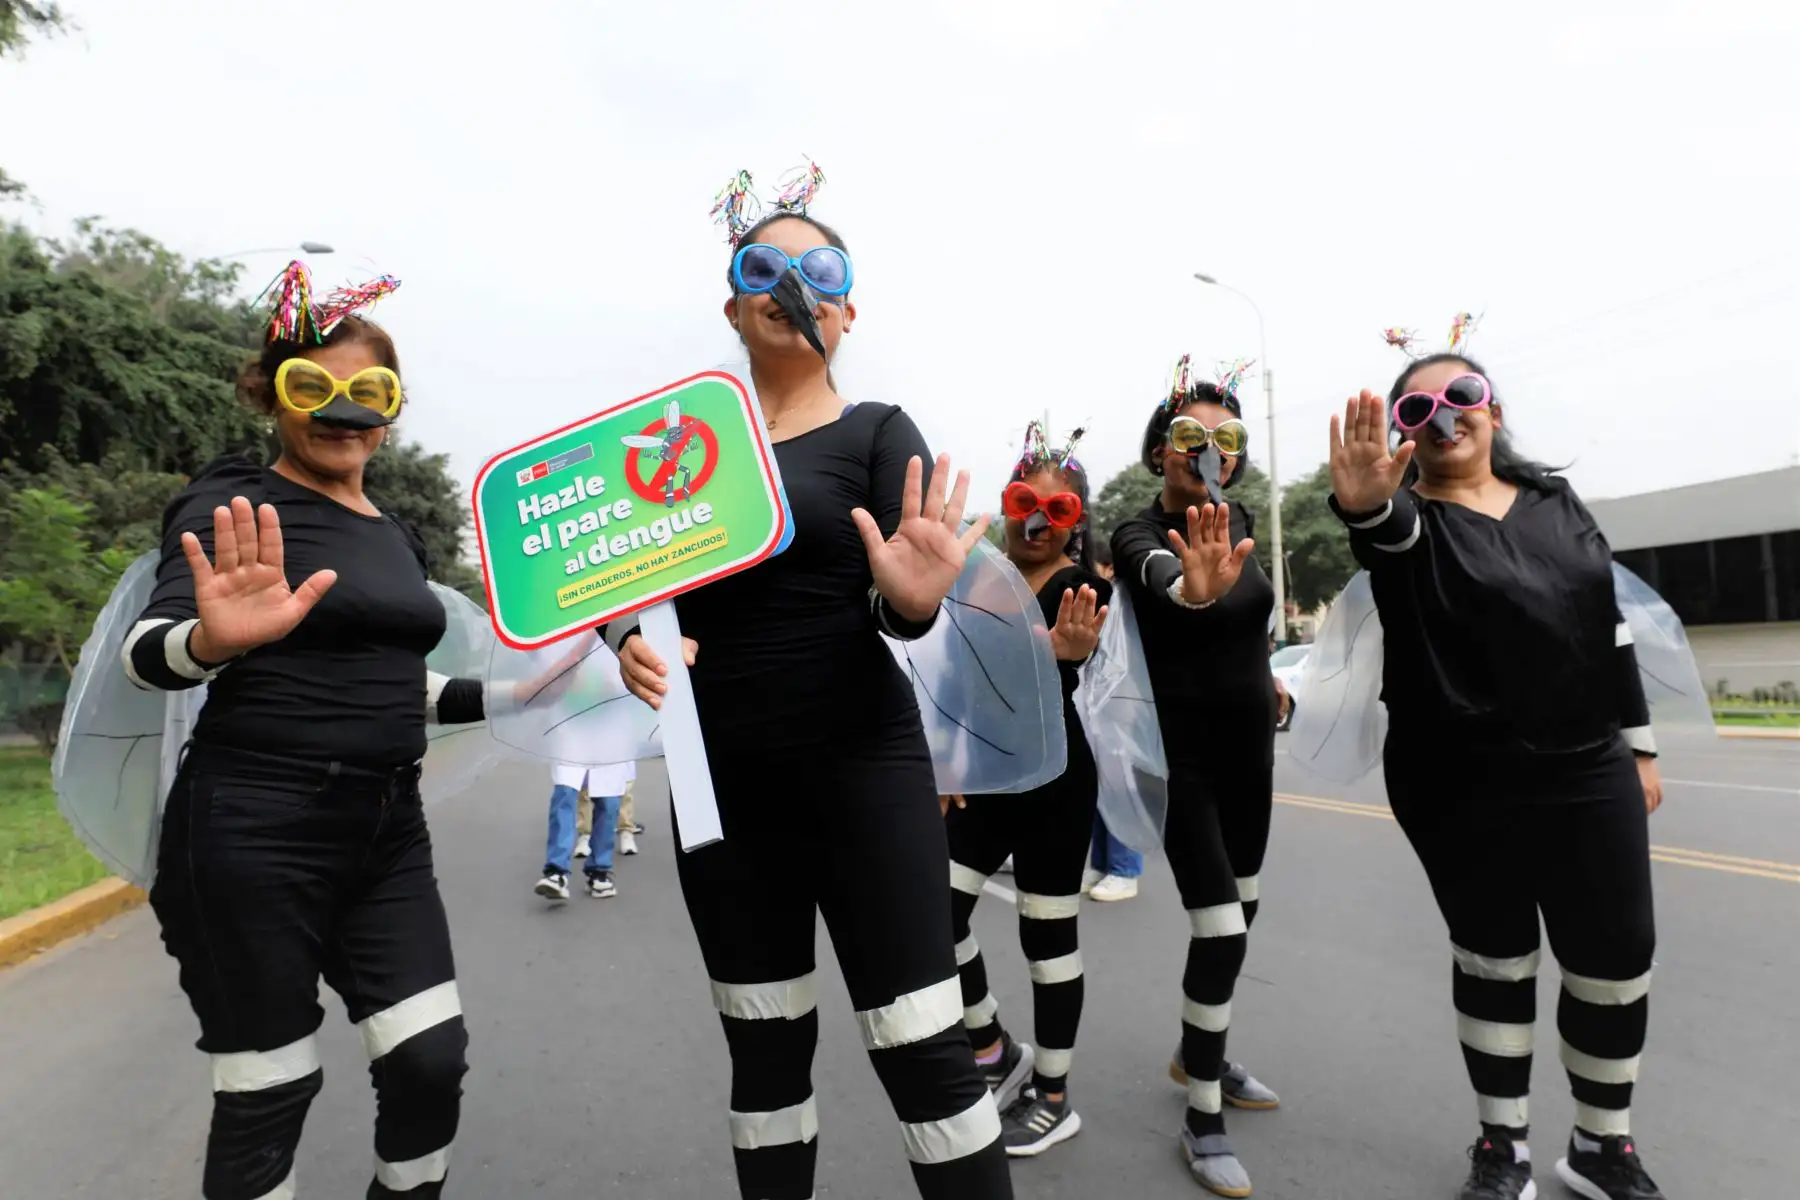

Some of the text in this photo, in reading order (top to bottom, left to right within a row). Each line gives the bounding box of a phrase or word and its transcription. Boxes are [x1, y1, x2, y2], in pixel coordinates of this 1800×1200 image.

[517, 475, 605, 524] Hazle
[522, 498, 633, 556] el pare
[564, 502, 713, 574] al dengue
[579, 568, 635, 595] CRIADEROS,
[635, 562, 650, 573] NO
[650, 554, 669, 567] HAY
[671, 531, 726, 559] ZANCUDOS!
